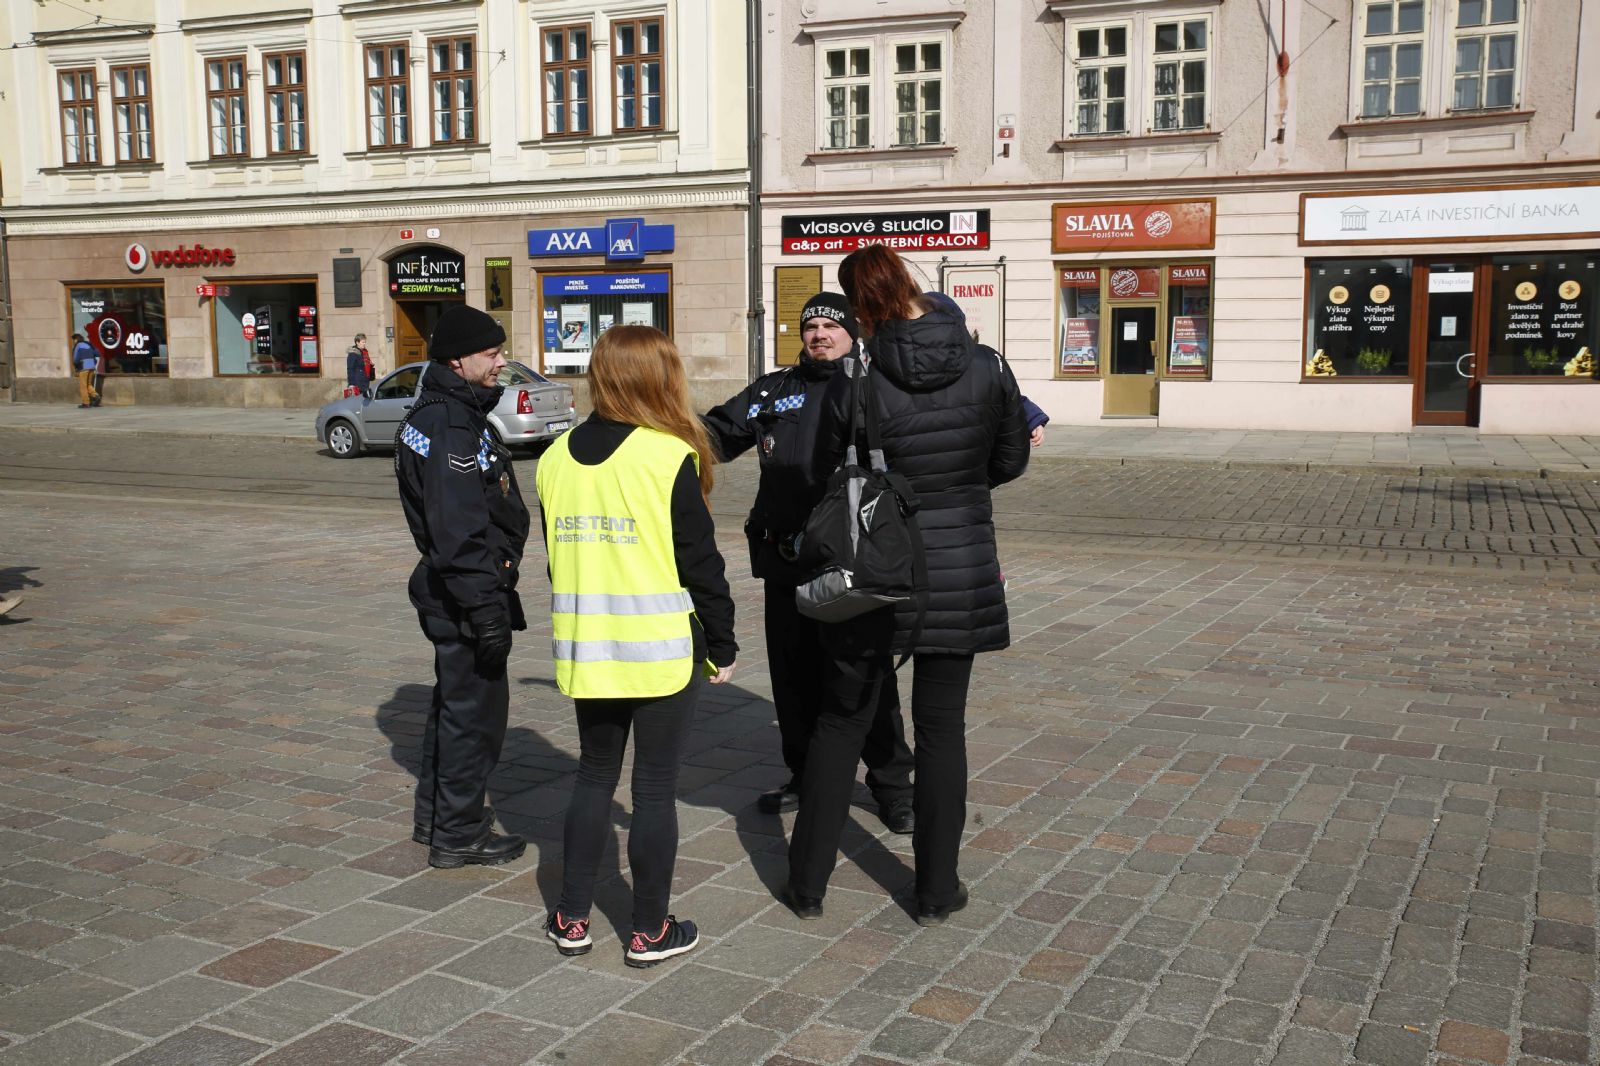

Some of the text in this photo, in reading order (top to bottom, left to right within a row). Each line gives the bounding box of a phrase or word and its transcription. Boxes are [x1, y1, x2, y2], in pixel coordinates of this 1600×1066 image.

[1378, 203, 1580, 223] ZLATÁ INVESTIČNÍ BANKA
[800, 215, 974, 234] vlasové studio IN
[1066, 213, 1134, 231] SLAVIA
[1092, 231, 1134, 239] POJIŠŤOVNA
[545, 232, 592, 251] AXA
[611, 239, 634, 252] AXA
[791, 241, 820, 252] a&p
[824, 239, 843, 249] art
[926, 235, 978, 247] SALON
[151, 244, 235, 267] vodafone
[1064, 270, 1096, 280] SLAVIA
[1172, 268, 1206, 278] SLAVIA
[401, 284, 433, 293] SEGWAY
[953, 284, 994, 298] FRANCIS
[1326, 305, 1351, 314] Výkup
[1364, 305, 1395, 314] Nejlepší
[1560, 302, 1577, 311] Ryzí
[1364, 314, 1395, 323] výkupní
[1554, 313, 1582, 321] partner
[1369, 325, 1387, 333] ceny
[1508, 322, 1540, 330] skvělých
[1505, 332, 1543, 340] podmínek
[1557, 331, 1577, 339] kovy
[126, 332, 144, 349] 40
[599, 534, 639, 544] POLICIE
